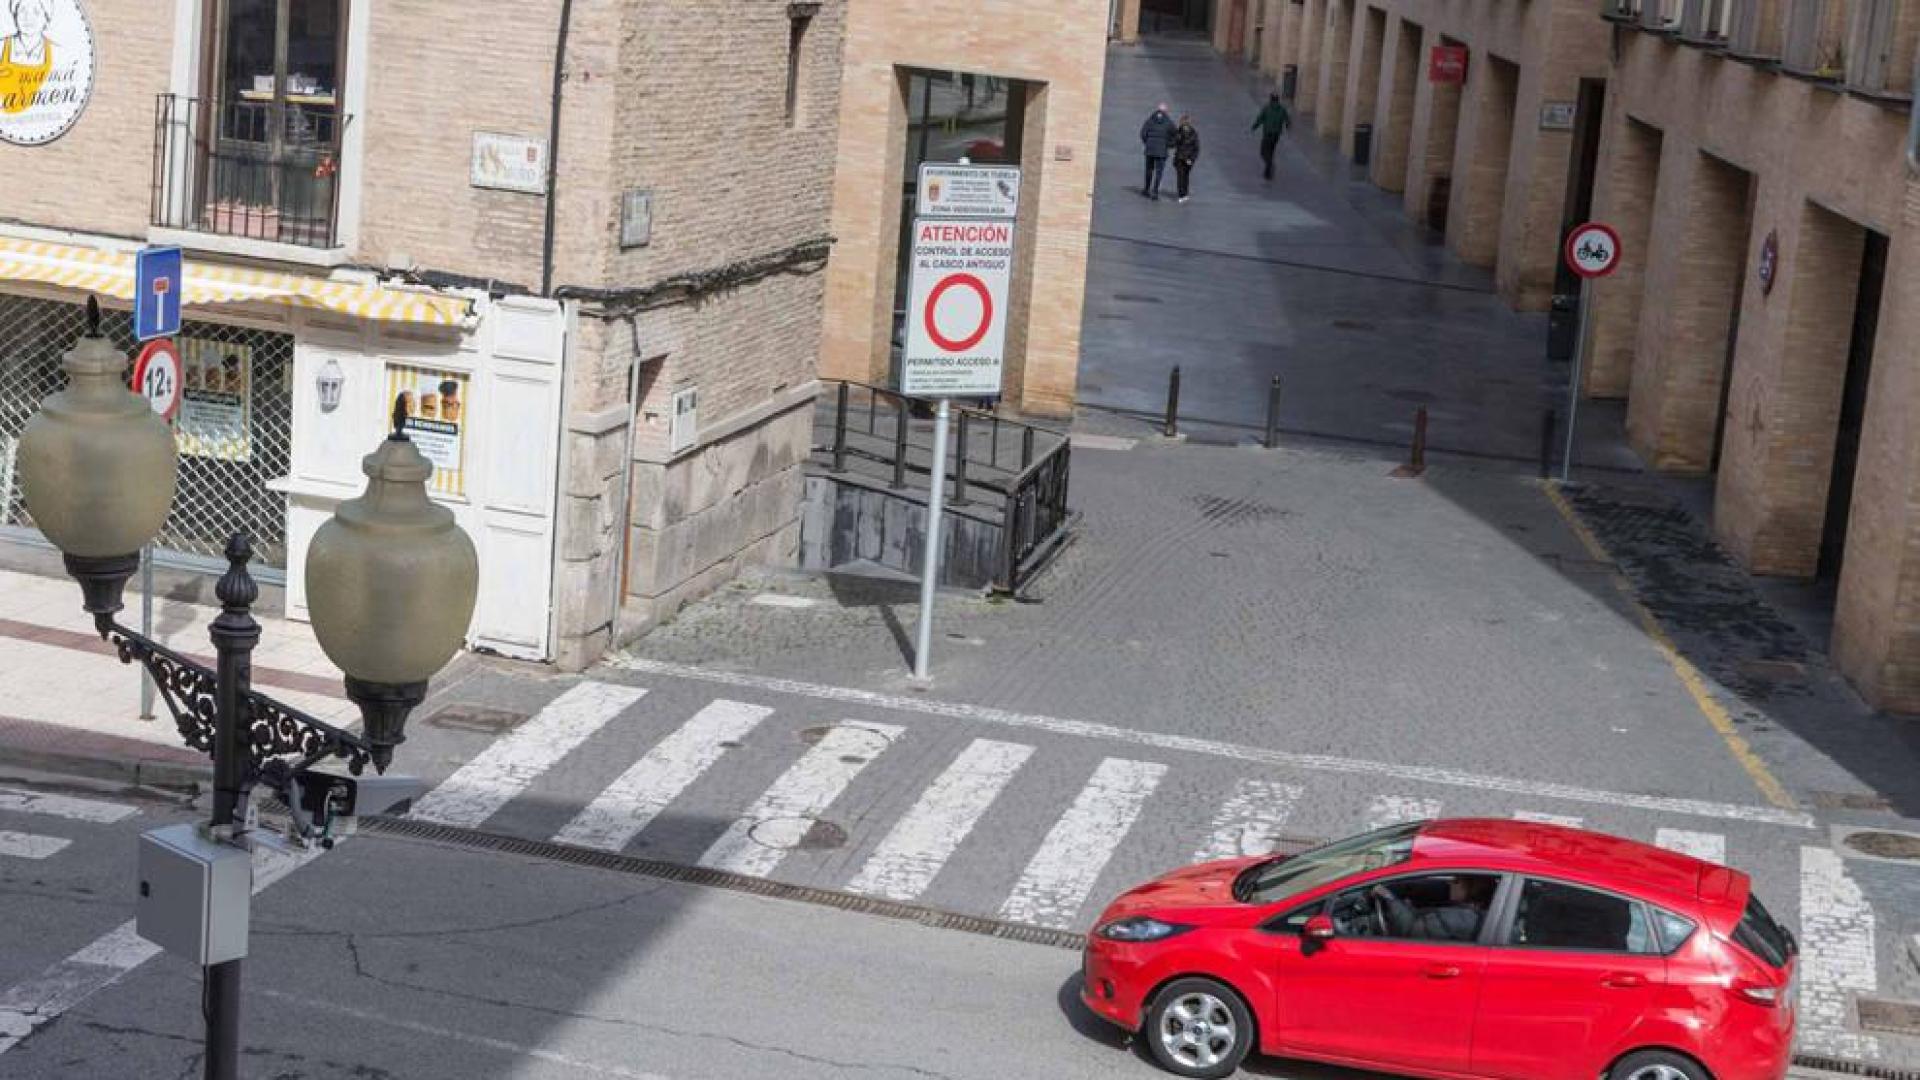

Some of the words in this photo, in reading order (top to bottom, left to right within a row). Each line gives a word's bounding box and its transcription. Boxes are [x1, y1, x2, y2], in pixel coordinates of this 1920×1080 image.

[0, 86, 77, 108] armen
[920, 222, 1008, 241] ATENCIÓN
[916, 245, 958, 256] CONTROL
[959, 247, 973, 257] DE
[975, 247, 1011, 257] ACCESO
[919, 259, 930, 269] AL
[932, 259, 964, 270] CASCO
[966, 259, 1006, 270] ANTIGUO
[907, 357, 954, 367] PERMITIDO
[957, 357, 992, 367] ACCESO
